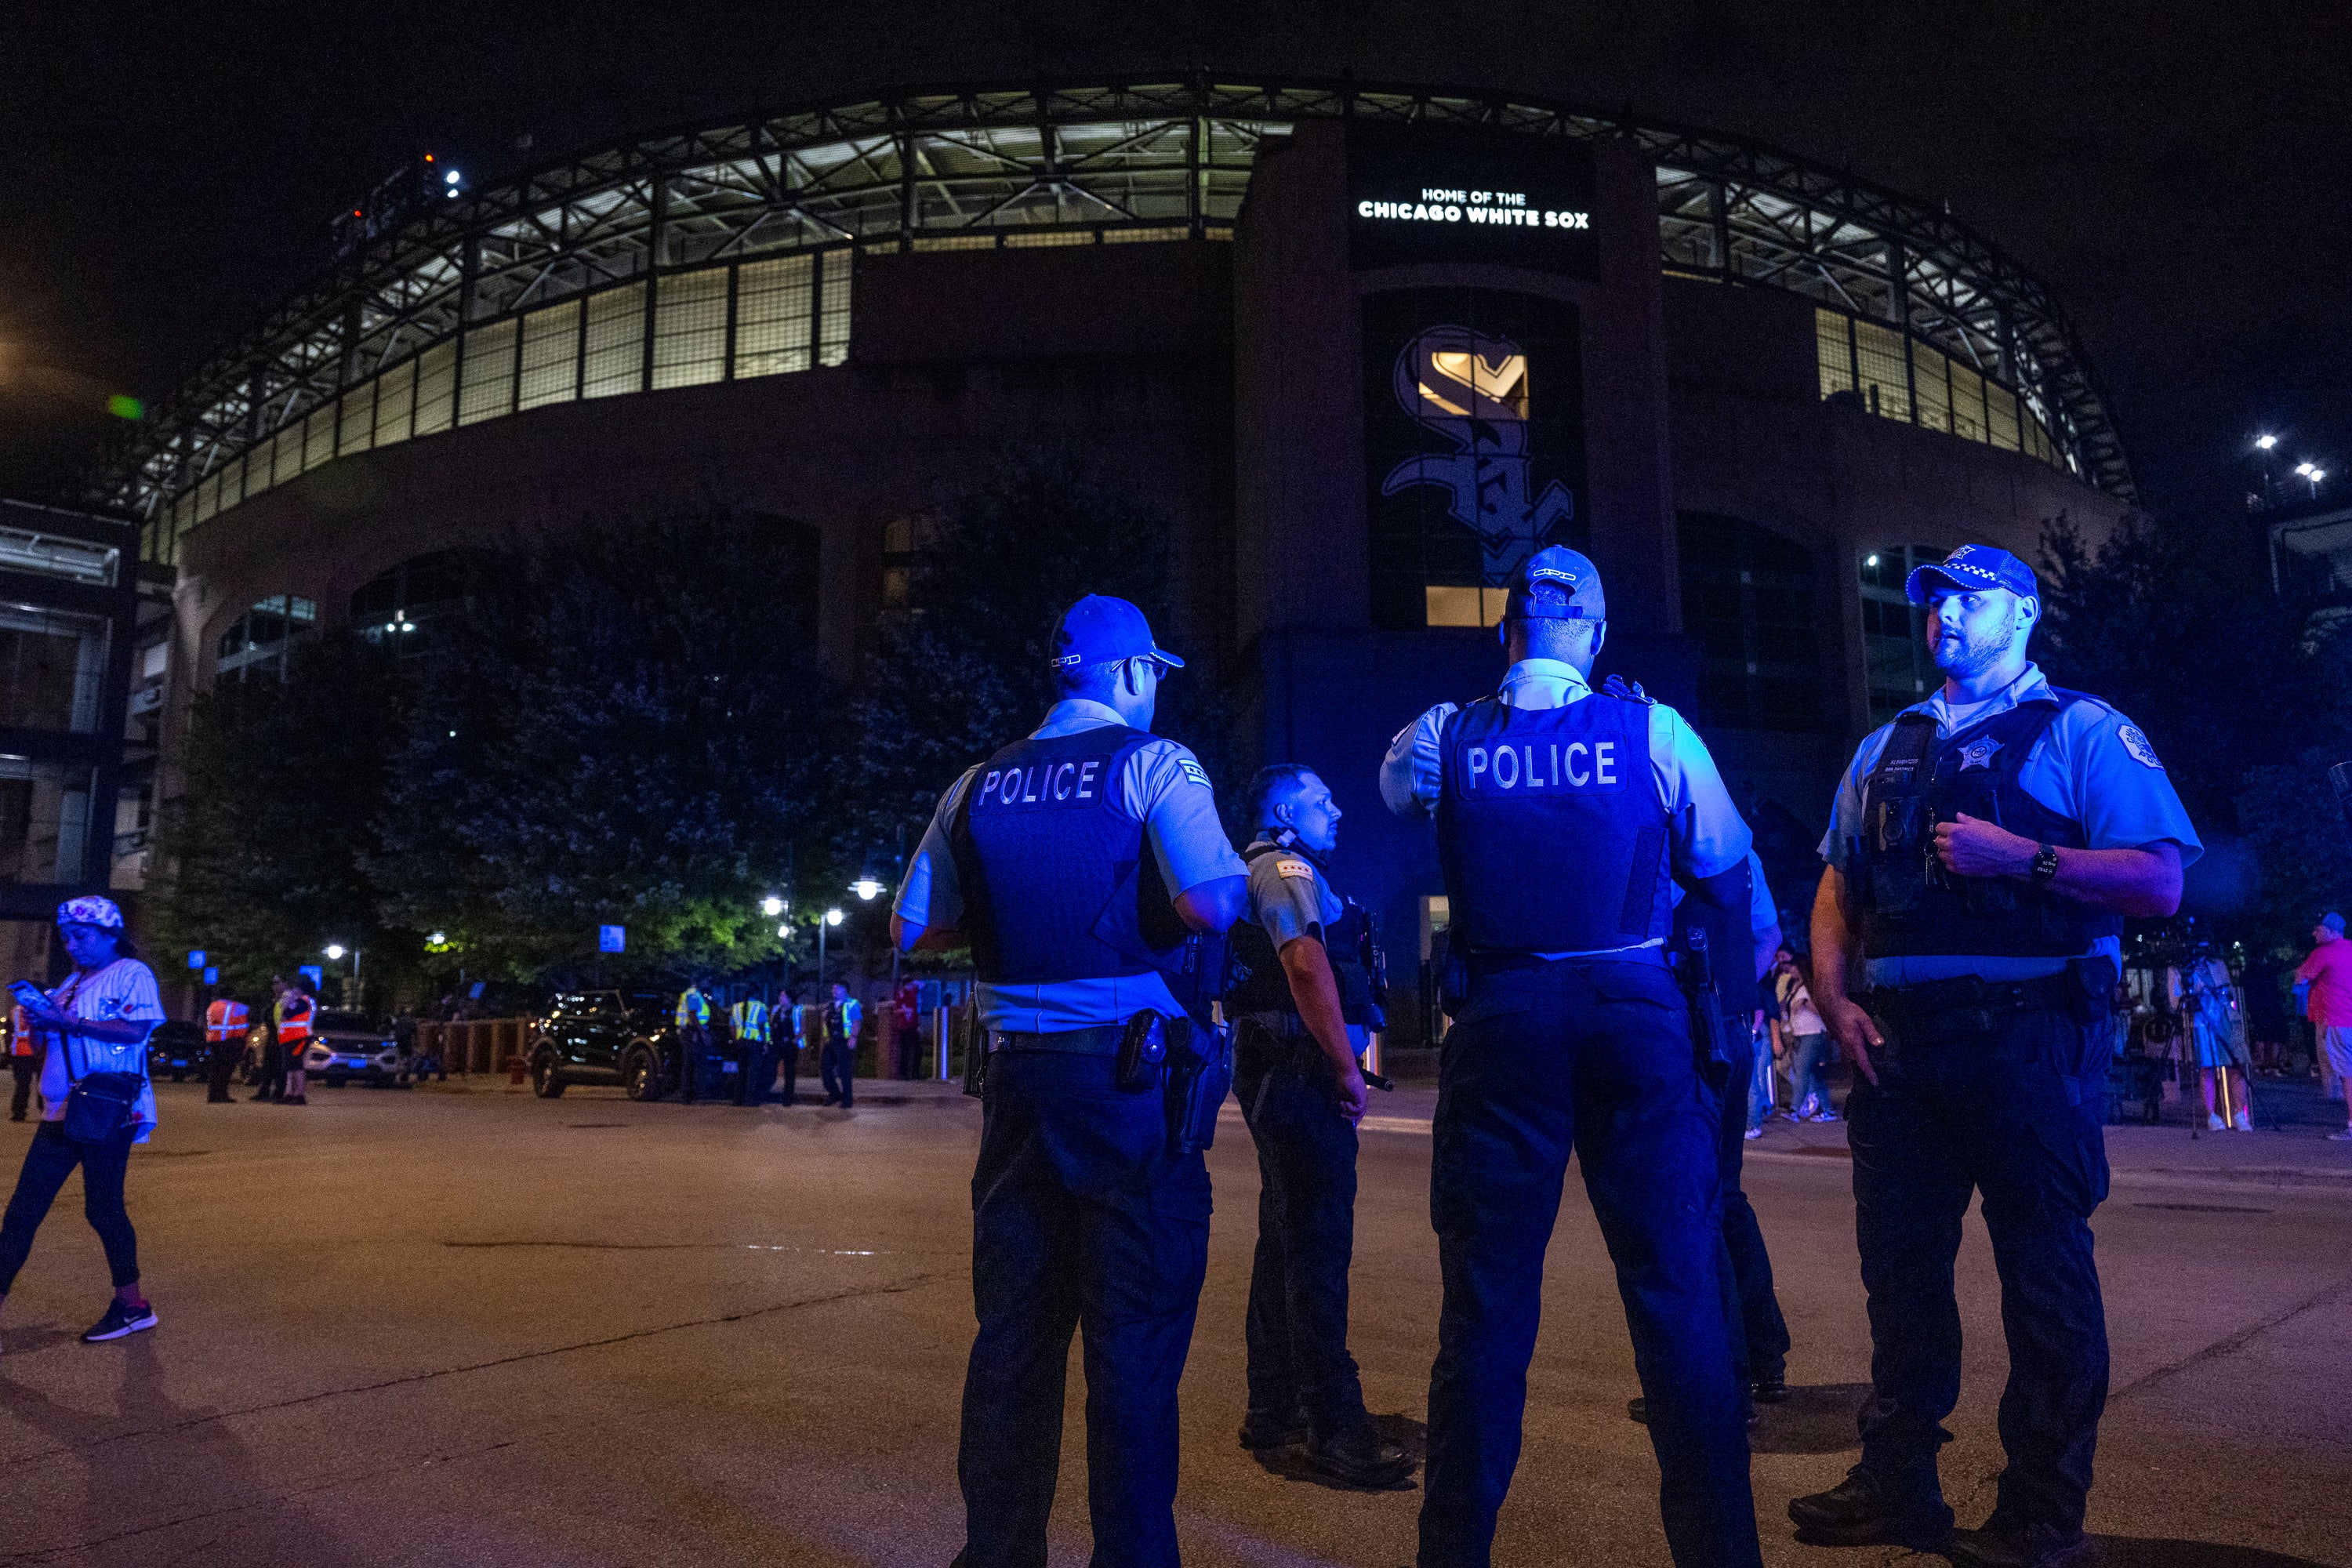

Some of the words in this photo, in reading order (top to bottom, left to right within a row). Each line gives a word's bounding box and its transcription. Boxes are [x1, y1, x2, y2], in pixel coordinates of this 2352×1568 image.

[1421, 187, 1468, 204] HOME
[1470, 191, 1493, 204] OF
[1495, 192, 1526, 206] THE
[1358, 201, 1461, 222] CHICAGO
[1465, 206, 1540, 226] WHITE
[1544, 210, 1589, 228] SOX
[1534, 568, 1577, 581] CPD
[1051, 654, 1081, 667] CPD
[1468, 742, 1617, 789] POLICE
[978, 761, 1099, 807] POLICE
